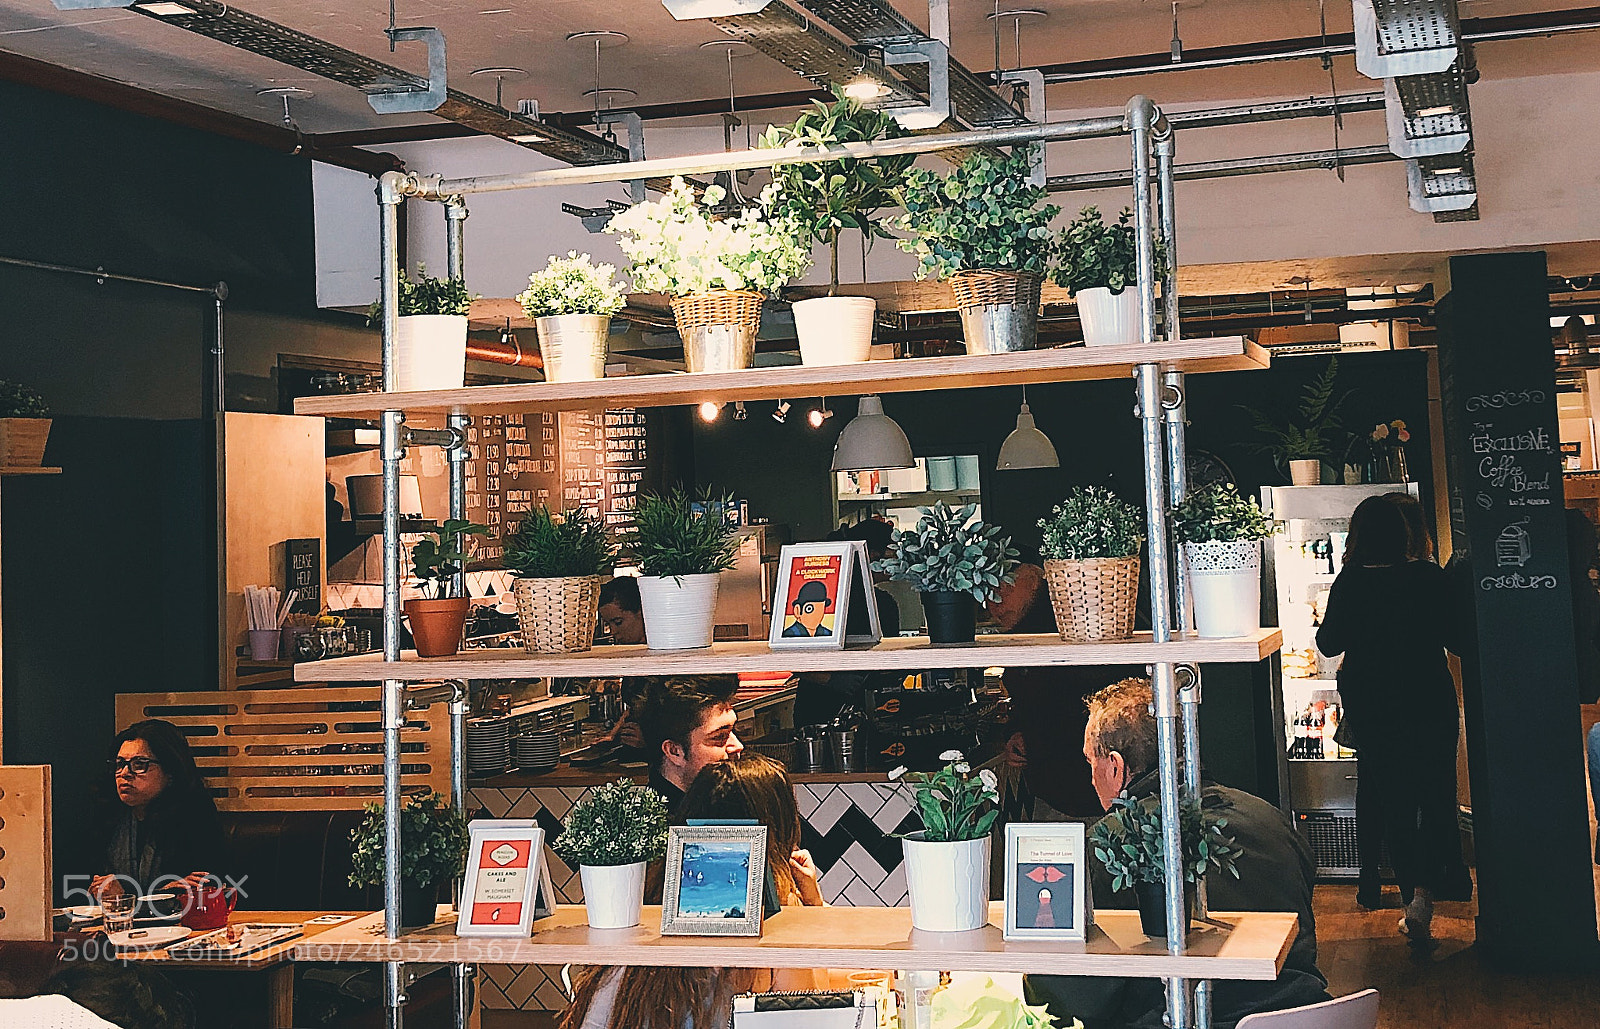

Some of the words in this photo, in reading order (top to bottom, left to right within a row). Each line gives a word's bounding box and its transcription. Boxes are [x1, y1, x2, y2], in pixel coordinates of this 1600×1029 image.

[1479, 455, 1523, 487] Coffee
[1510, 472, 1549, 491] Blend
[293, 554, 312, 569] PLEASE
[296, 571, 311, 585] HELP
